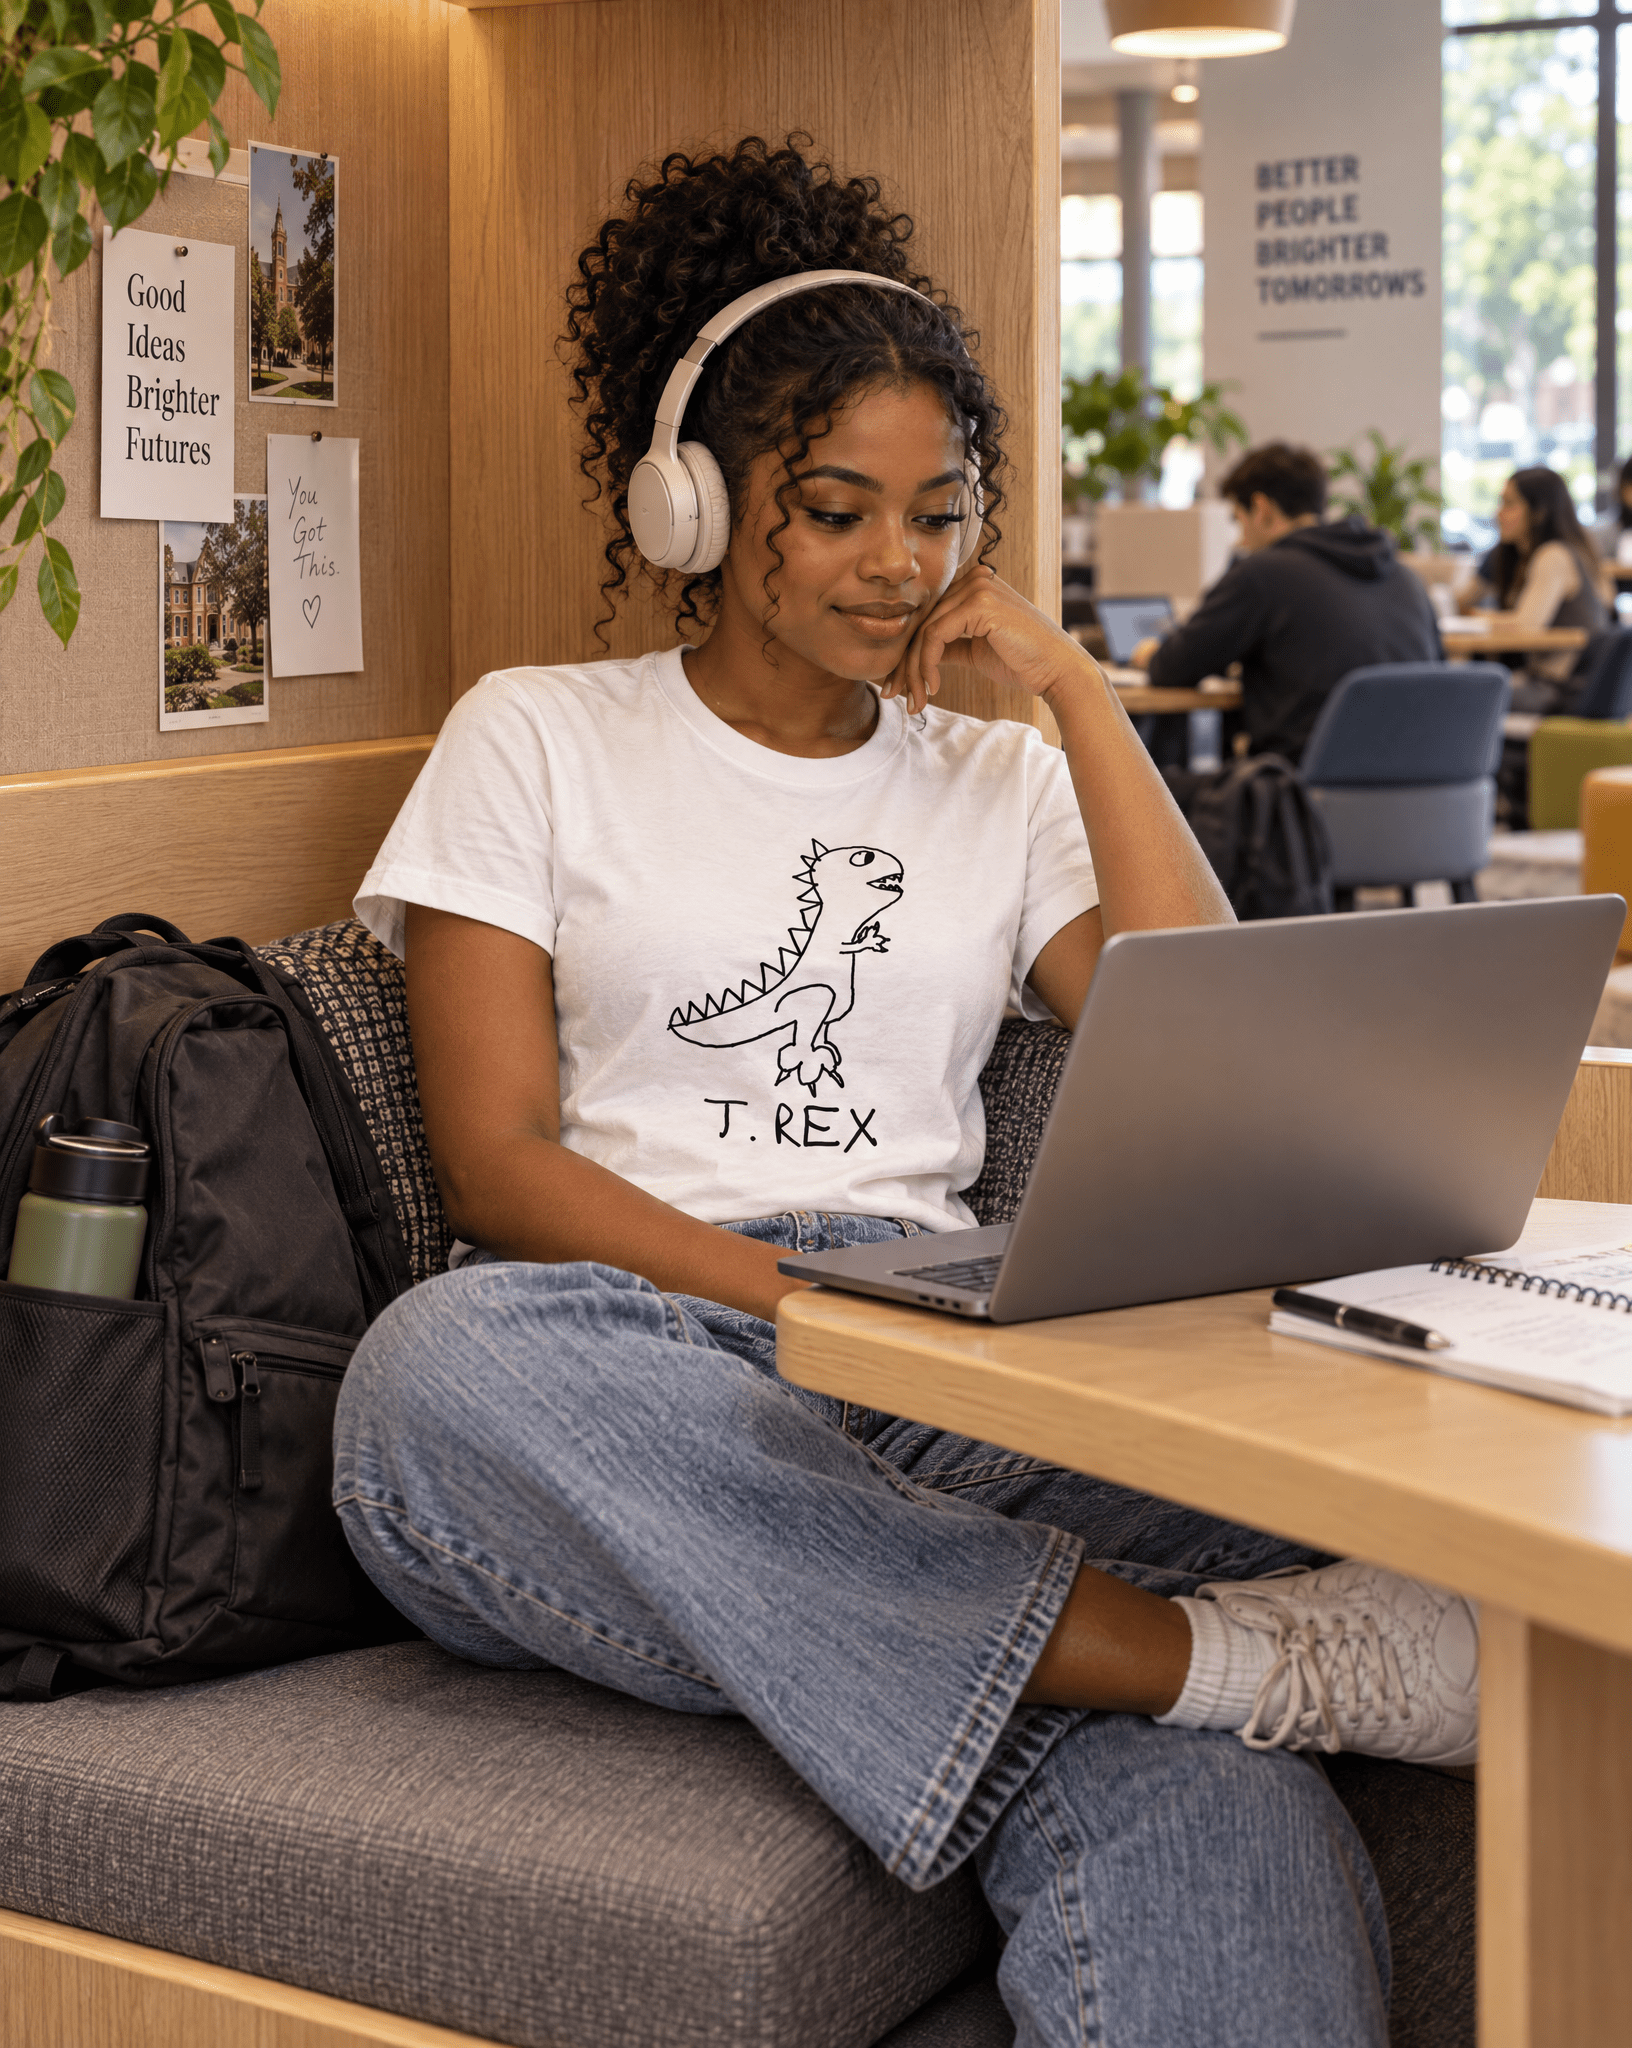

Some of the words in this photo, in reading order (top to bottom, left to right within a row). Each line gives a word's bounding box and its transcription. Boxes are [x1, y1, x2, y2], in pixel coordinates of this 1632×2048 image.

[1256, 155, 1358, 190] BETTER
[1256, 195, 1357, 229] PEOPLE
[1256, 231, 1388, 267] BRIGHTER
[128, 273, 186, 313] Good
[1257, 269, 1425, 304] TOMORROWS
[127, 323, 185, 362] Ideas
[127, 375, 220, 421] Brighter
[126, 426, 211, 465] Futures
[288, 476, 318, 520] You
[293, 516, 327, 554] Got
[293, 551, 340, 579] This.
